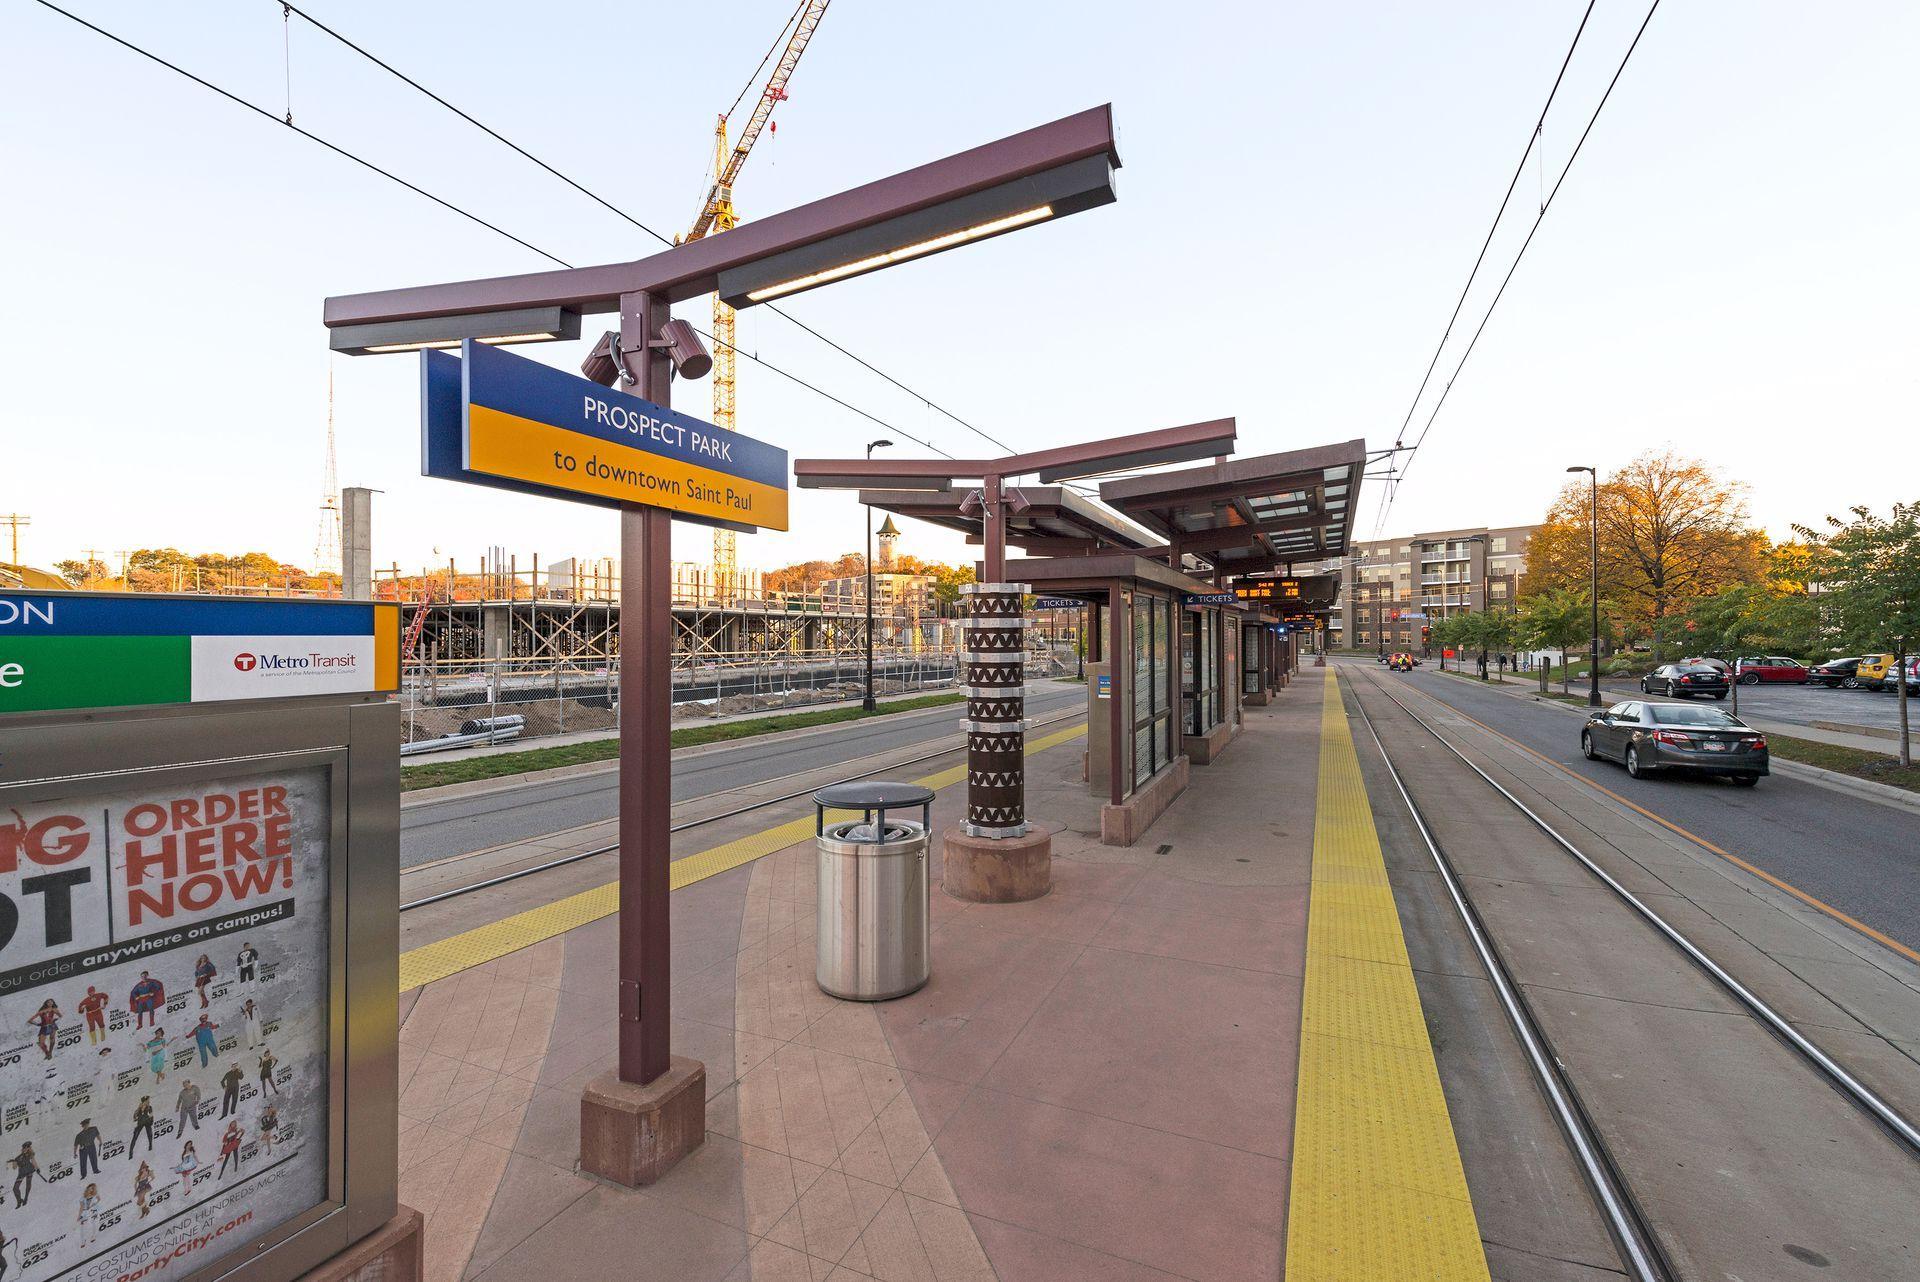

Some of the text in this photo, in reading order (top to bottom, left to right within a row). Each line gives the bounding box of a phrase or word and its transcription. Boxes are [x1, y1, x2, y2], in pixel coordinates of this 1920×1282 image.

[584, 395, 733, 463] PROSPECT PARK
[554, 450, 753, 512] to downtown Saint Paul
[1199, 594, 1232, 603] TICKETS
[260, 655, 309, 669] Metro
[309, 653, 356, 667] Transit
[0, 663, 24, 687] e
[124, 786, 288, 837] ORDER
[126, 815, 292, 886] HERE
[128, 857, 293, 926] NOW!
[30, 962, 75, 981] order
[82, 932, 182, 967] anywhere
[188, 926, 210, 939] on
[215, 904, 283, 931] campus!
[211, 988, 227, 999] 531
[166, 1001, 186, 1014] 803
[109, 1013, 129, 1022] MUSCLE
[57, 1024, 82, 1034] WONDER
[109, 1019, 129, 1032] 931
[262, 1024, 278, 1036] 876
[57, 1028, 81, 1039] WOMAN
[56, 1035, 81, 1049] 500
[218, 1040, 237, 1053] 983
[173, 1057, 192, 1070] 587
[117, 1077, 139, 1091] 529
[276, 1073, 292, 1086] 539
[66, 1095, 90, 1110] 972
[239, 1089, 257, 1102] 830
[197, 1106, 216, 1120] 847
[5, 1117, 28, 1133] 971
[153, 1125, 173, 1139] 550
[102, 1145, 124, 1161] 822
[240, 1149, 257, 1162] 559
[48, 1167, 73, 1184] 608
[192, 1172, 211, 1186] 579
[149, 1191, 169, 1207] 683
[87, 1168, 287, 1277] COSTUMES AND HUNDREDS MORE
[99, 1215, 121, 1232] 655
[100, 1217, 214, 1282] FOUND ONLINE AT
[116, 1211, 253, 1282] PartyCity.com
[22, 1250, 48, 1269] 623
